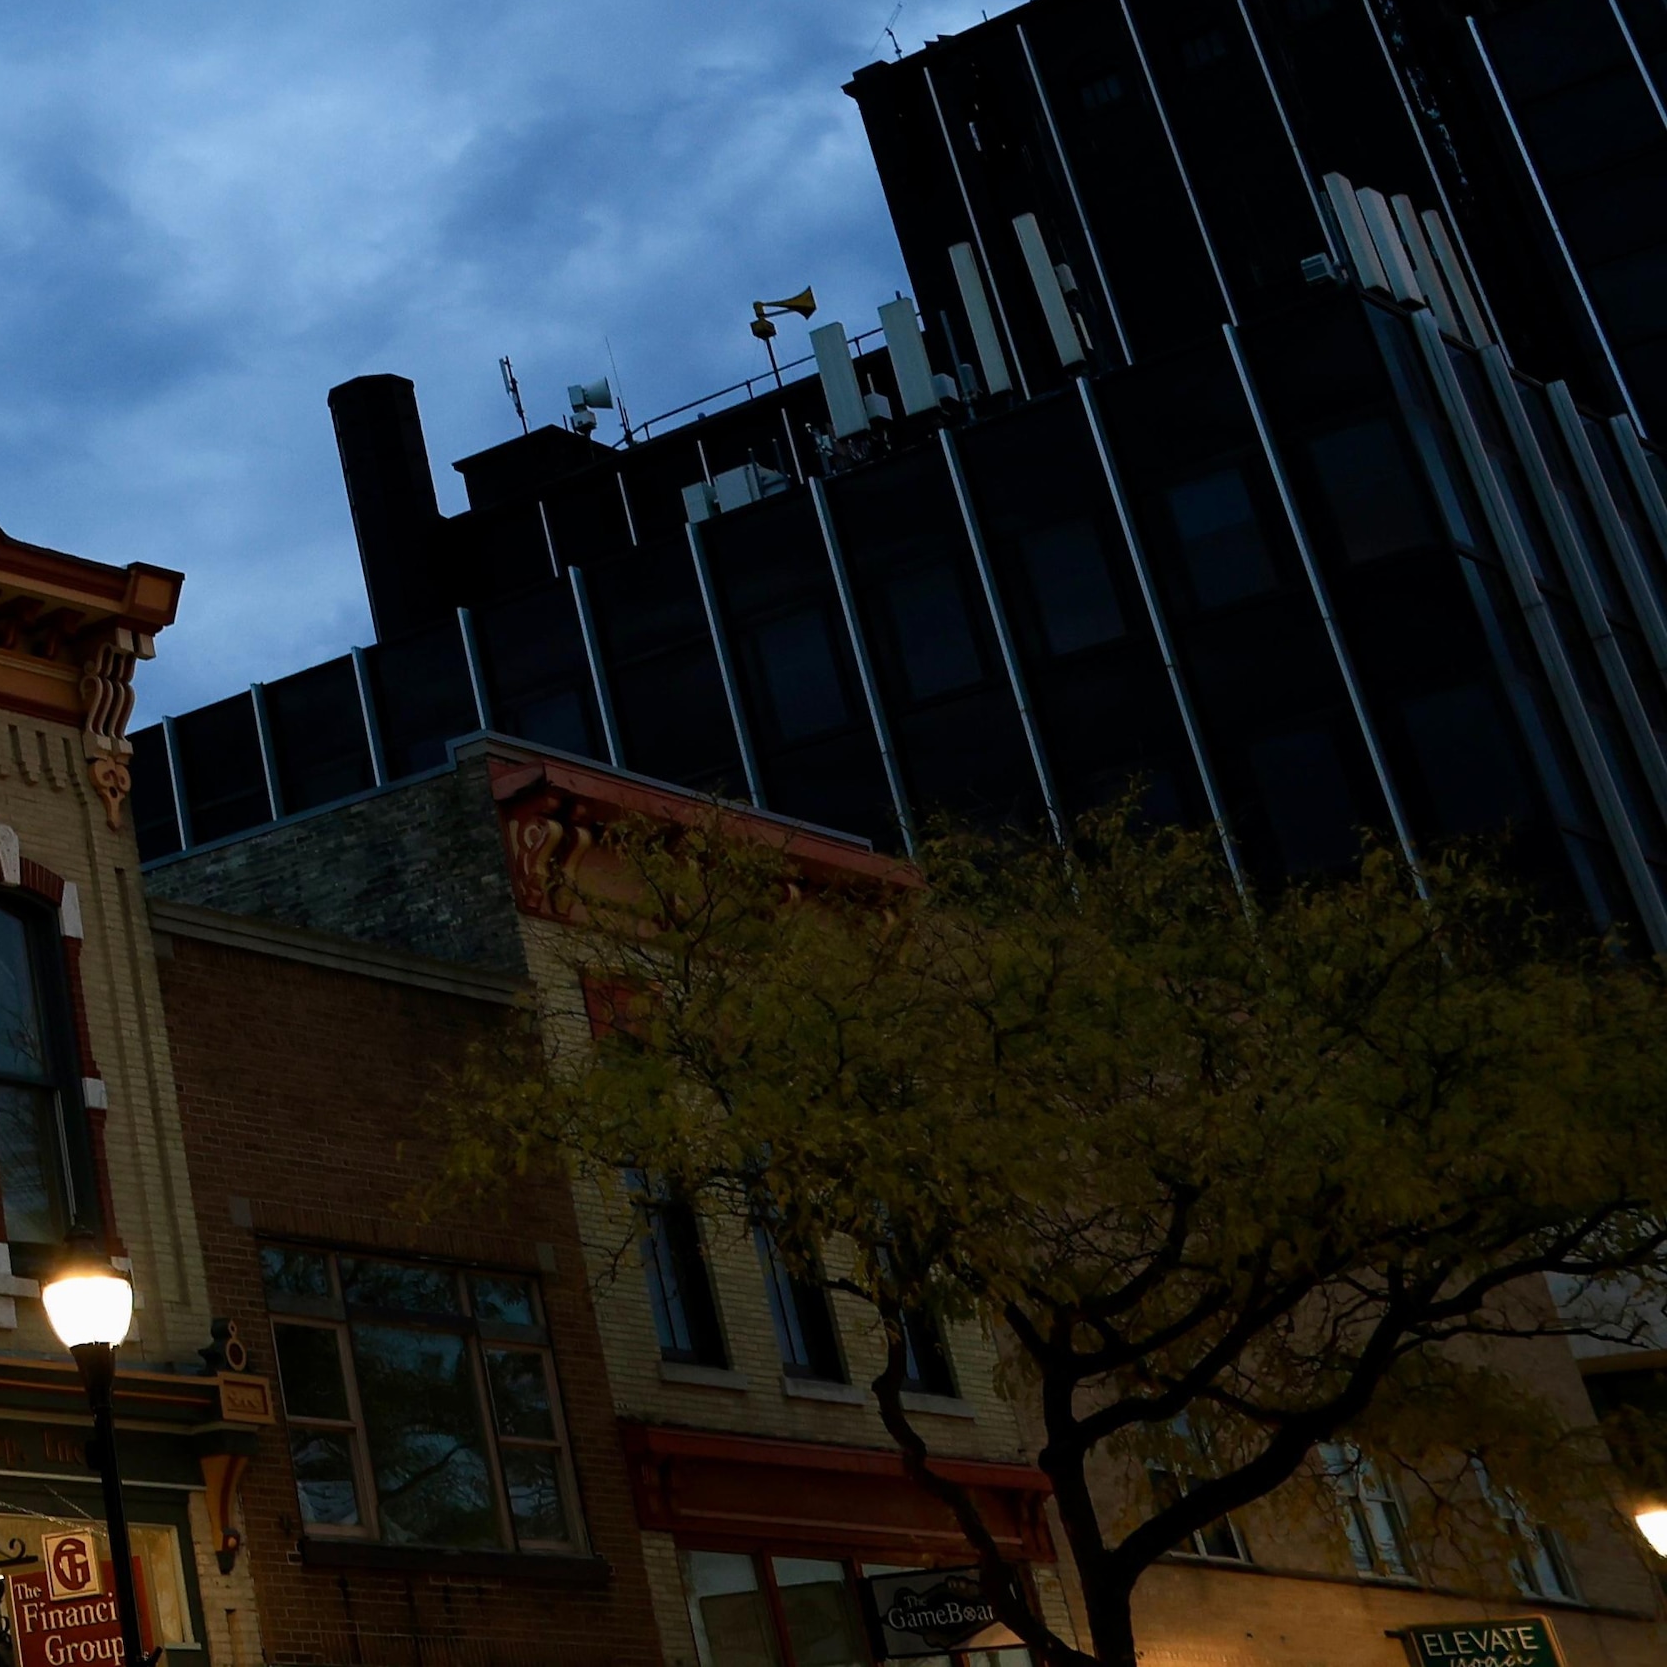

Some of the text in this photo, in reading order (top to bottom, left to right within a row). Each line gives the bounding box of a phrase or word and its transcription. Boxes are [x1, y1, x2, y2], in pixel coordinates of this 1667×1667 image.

[13, 1582, 43, 1601] The
[902, 1593, 929, 1608] The
[22, 1590, 119, 1634] Financi
[887, 1599, 998, 1631] GameBoar
[43, 1634, 127, 1667] Group
[1421, 1625, 1541, 1657] ELEVATE
